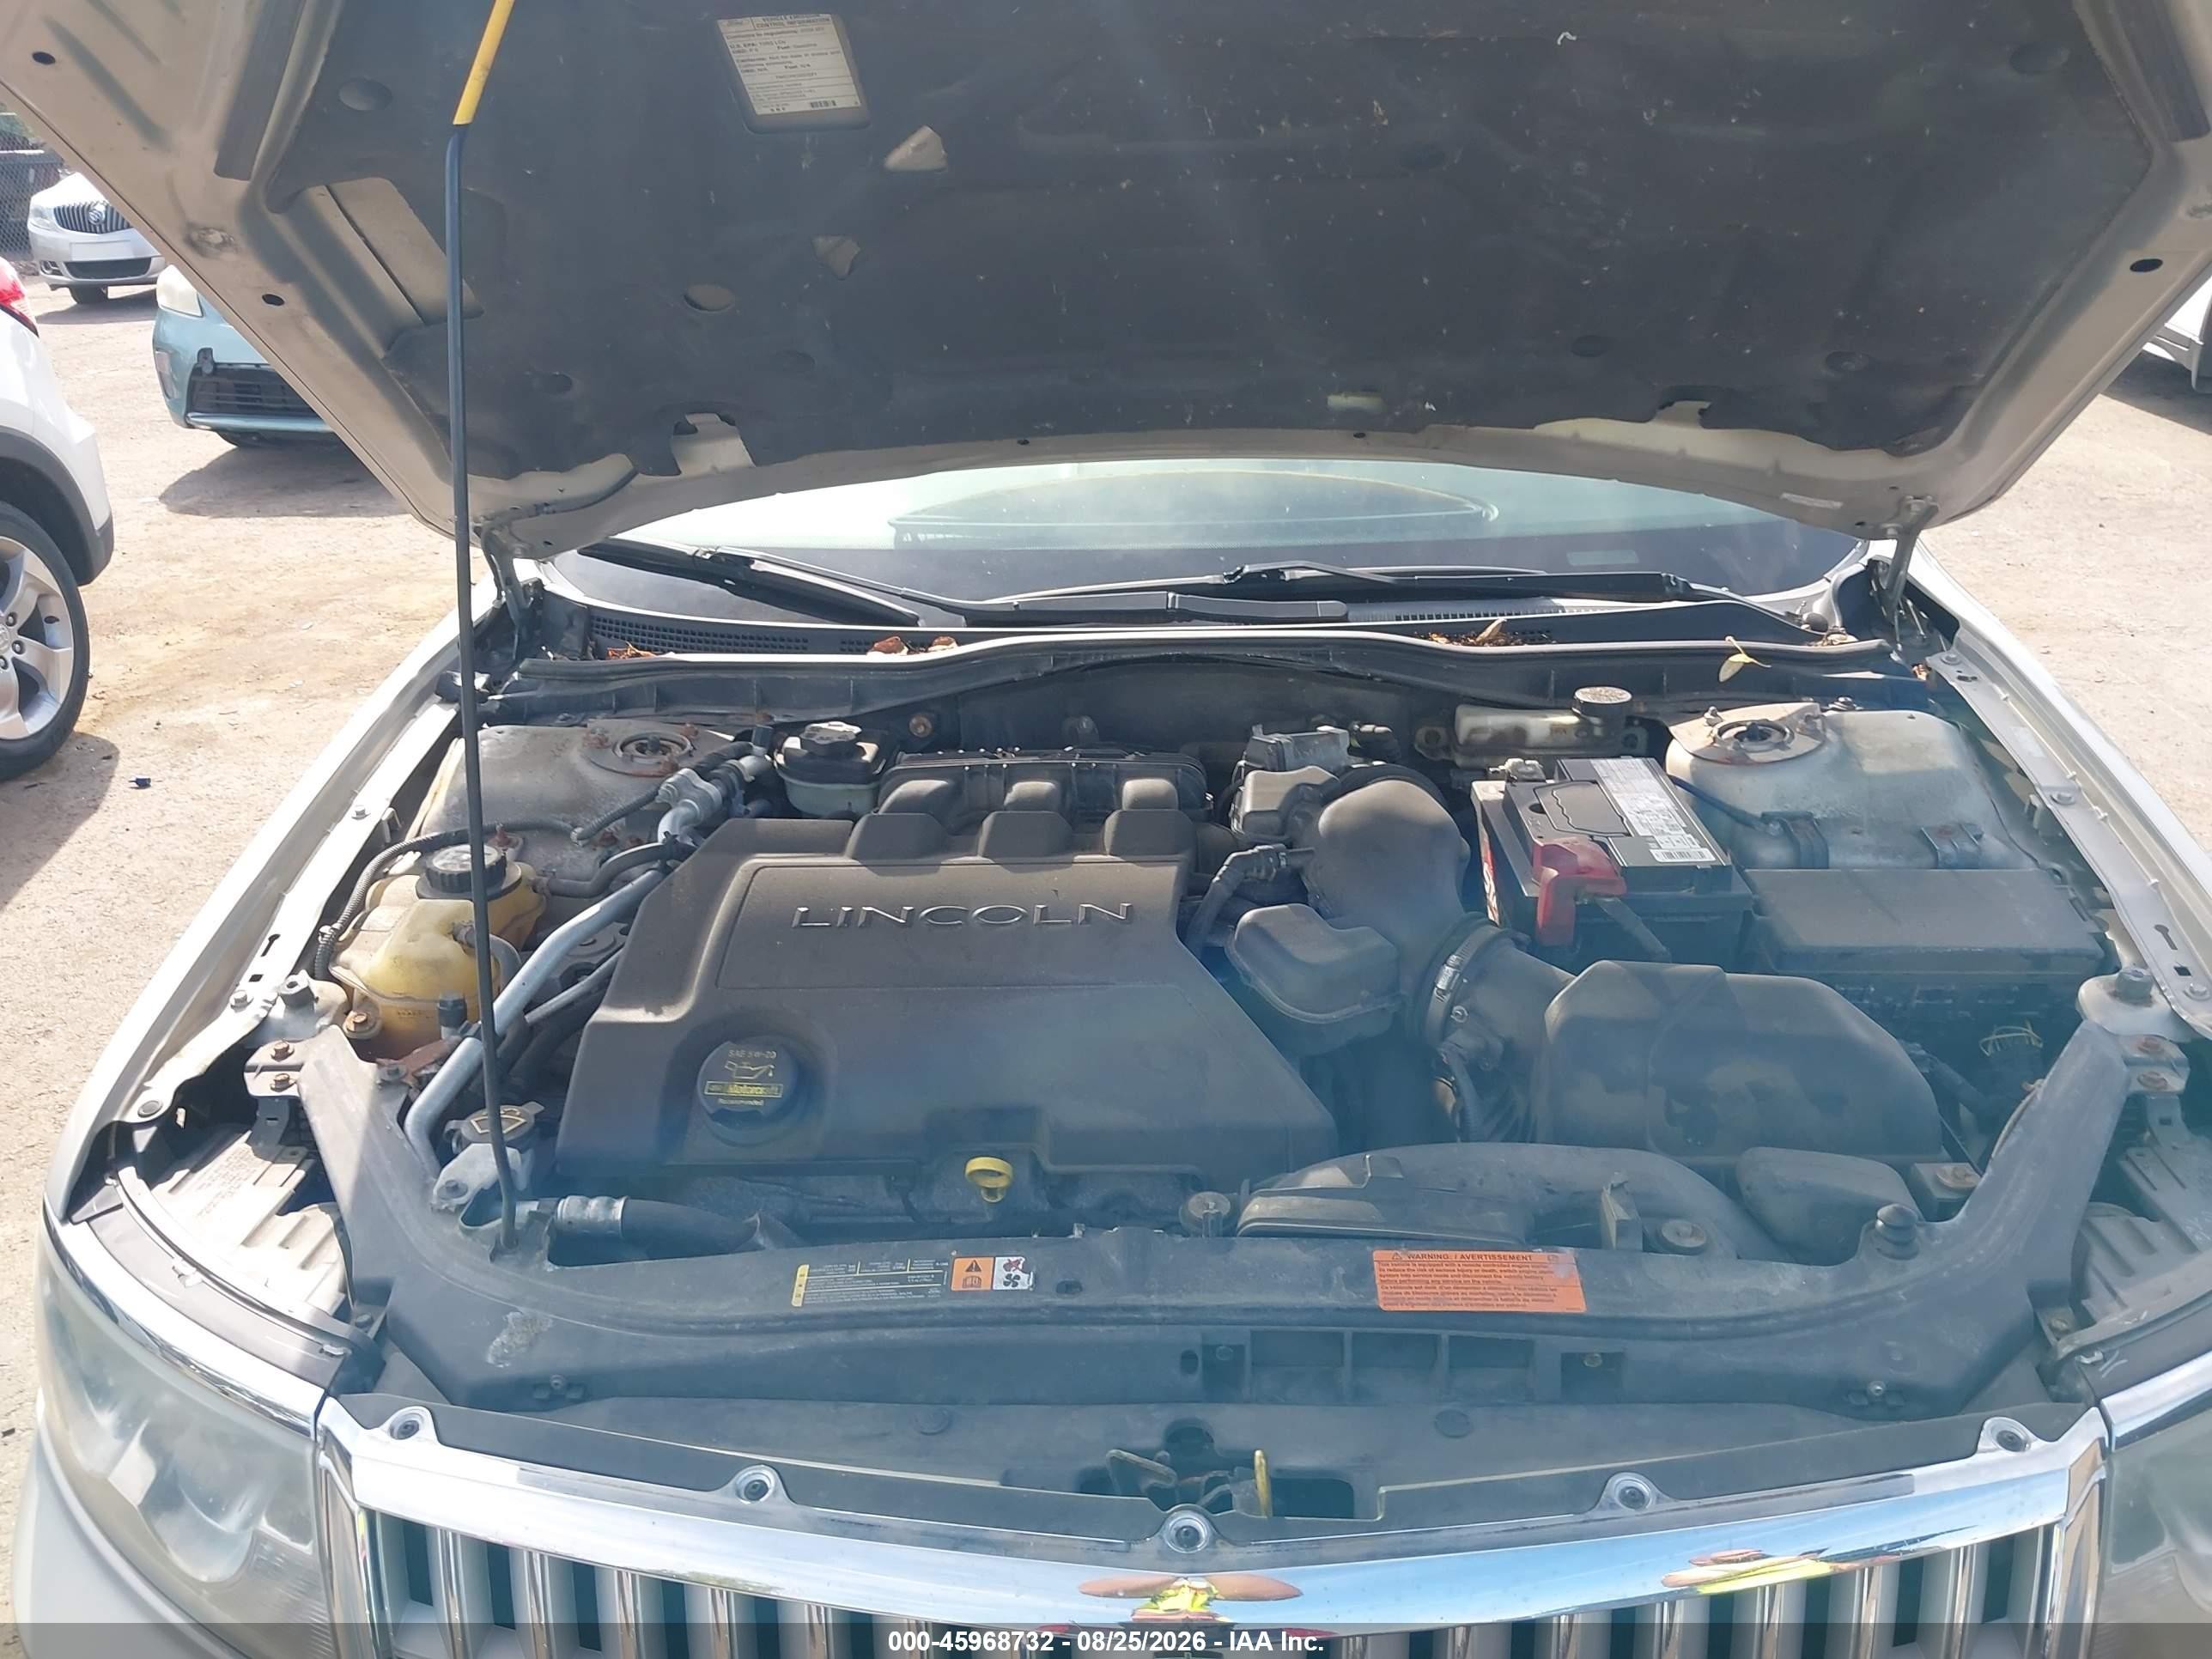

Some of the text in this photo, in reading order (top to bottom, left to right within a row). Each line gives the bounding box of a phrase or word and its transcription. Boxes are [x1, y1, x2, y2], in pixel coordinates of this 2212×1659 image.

[792, 902, 1133, 927] LINCOLN
[728, 1049, 777, 1059] SAE 5W-20
[1460, 1253, 1533, 1261] AVERTISSEMENT
